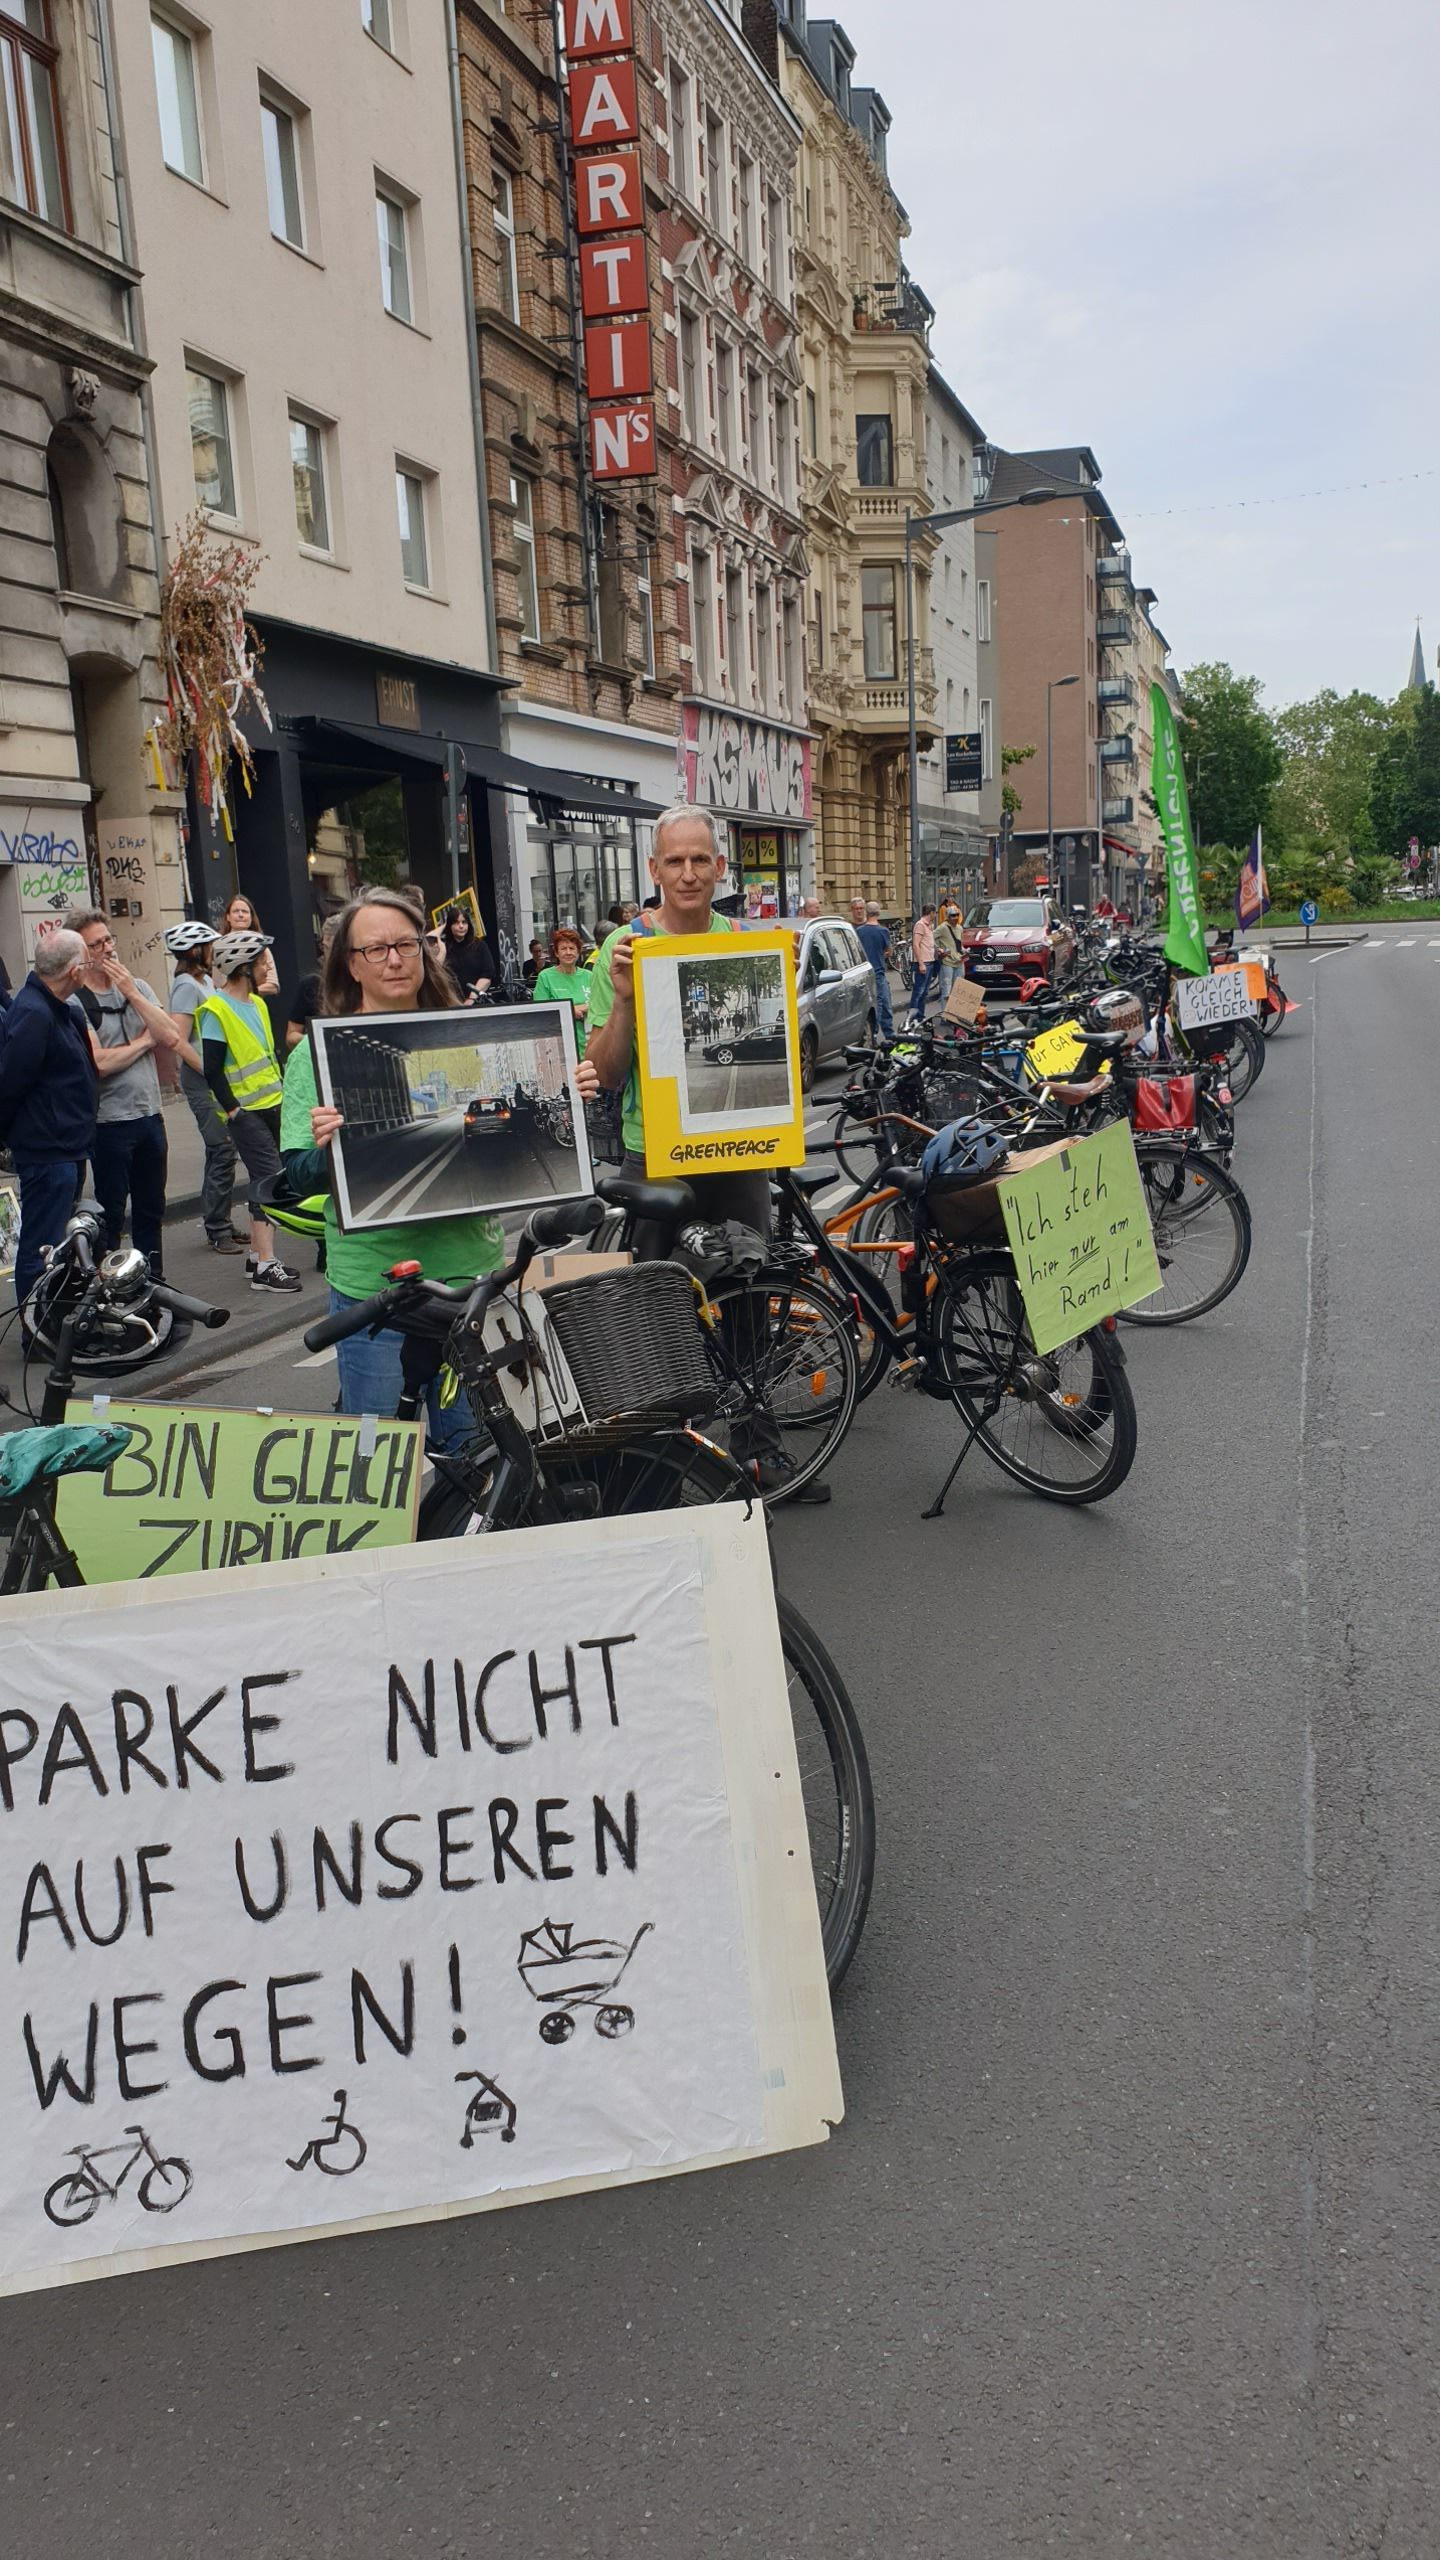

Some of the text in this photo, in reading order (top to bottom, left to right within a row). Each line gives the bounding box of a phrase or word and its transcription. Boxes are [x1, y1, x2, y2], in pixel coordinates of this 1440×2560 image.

[381, 676, 416, 712] ERNST
[761, 840, 775, 857] %
[1185, 971, 1241, 995] KOMME
[1191, 987, 1242, 1009] GLEICH
[670, 1137, 780, 1163] GREENPEACE
[1064, 1153, 1108, 1221] steh
[1029, 1217, 1129, 1285] hier nur am
[103, 1421, 417, 1509] BIN GLEICH
[0, 1633, 637, 1812] PARKE NICHT
[17, 1790, 638, 1963] AUF UNSEREN
